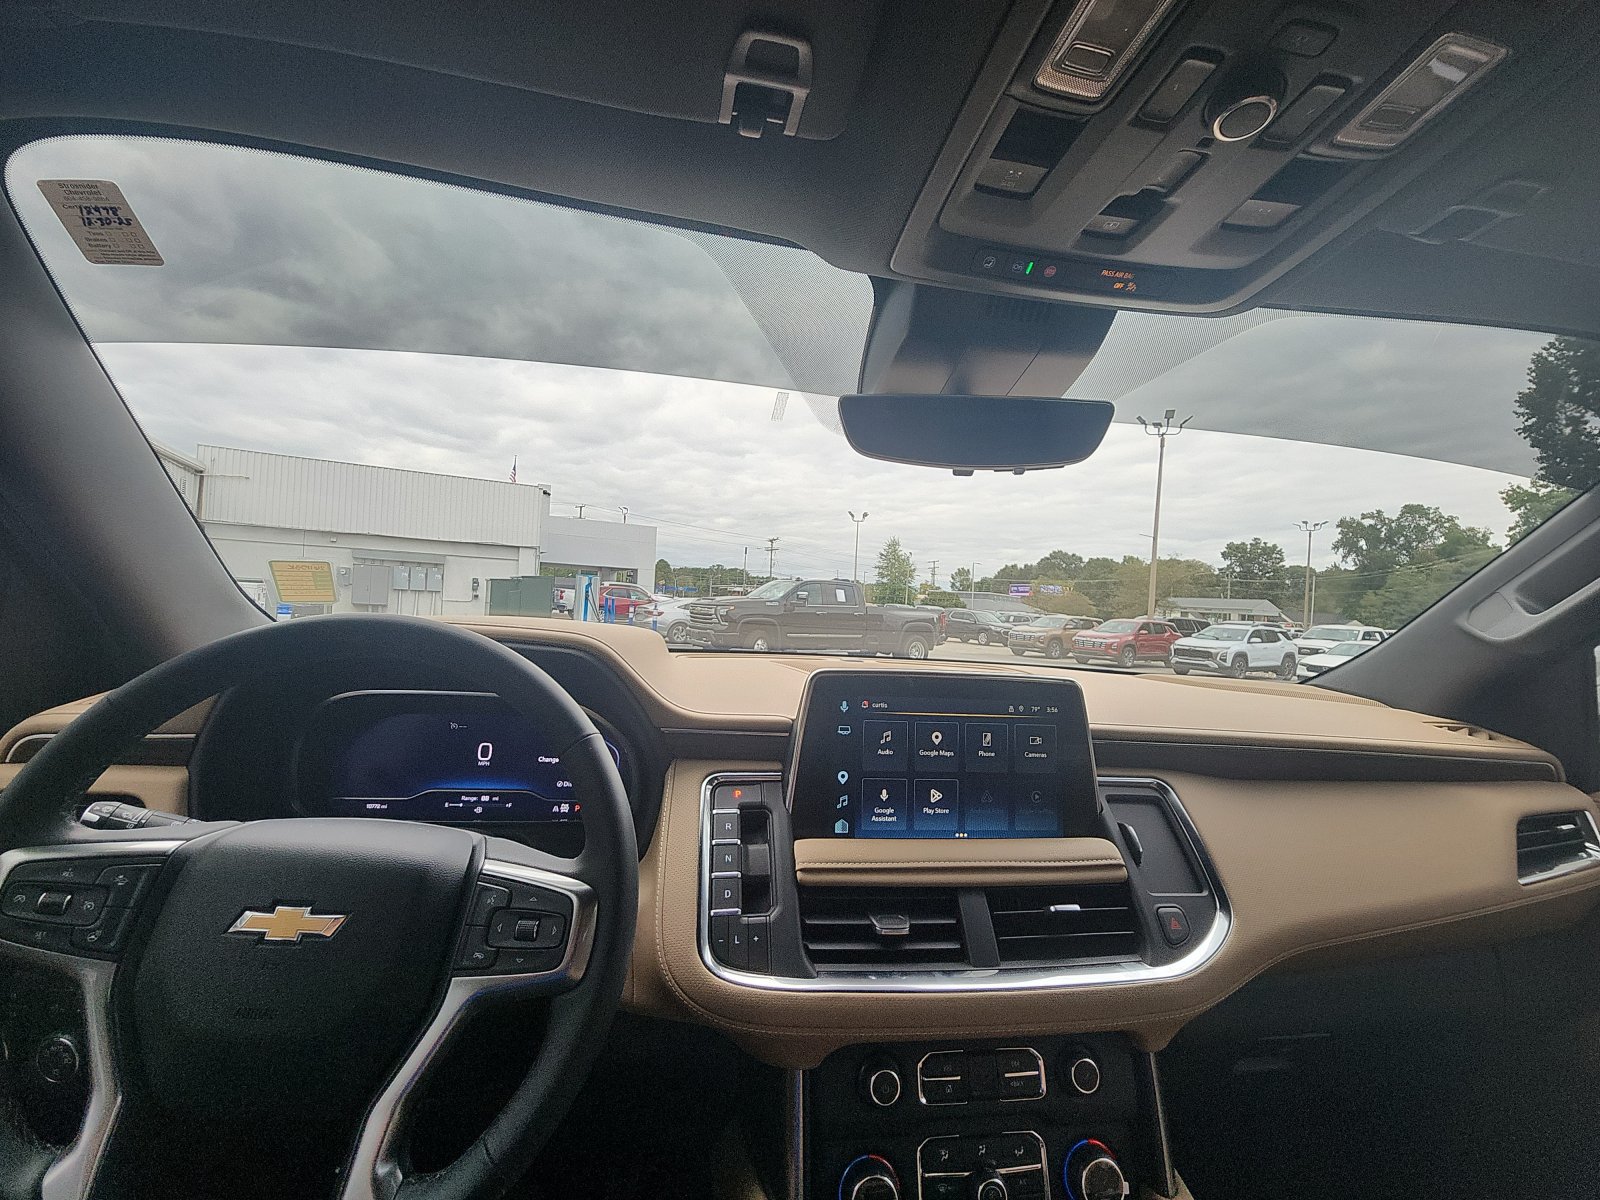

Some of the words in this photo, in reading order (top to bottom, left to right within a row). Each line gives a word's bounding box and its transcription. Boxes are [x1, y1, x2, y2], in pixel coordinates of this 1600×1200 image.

[1101, 269, 1115, 277] PASS
[477, 742, 493, 761] 0
[919, 749, 938, 757] Google
[538, 756, 560, 764] Change
[734, 789, 741, 798] P
[574, 804, 581, 812] P
[874, 806, 894, 814] Google
[922, 807, 935, 815] Play
[725, 822, 732, 831] R
[725, 854, 732, 863] N
[724, 889, 731, 898] D
[734, 934, 740, 944] L
